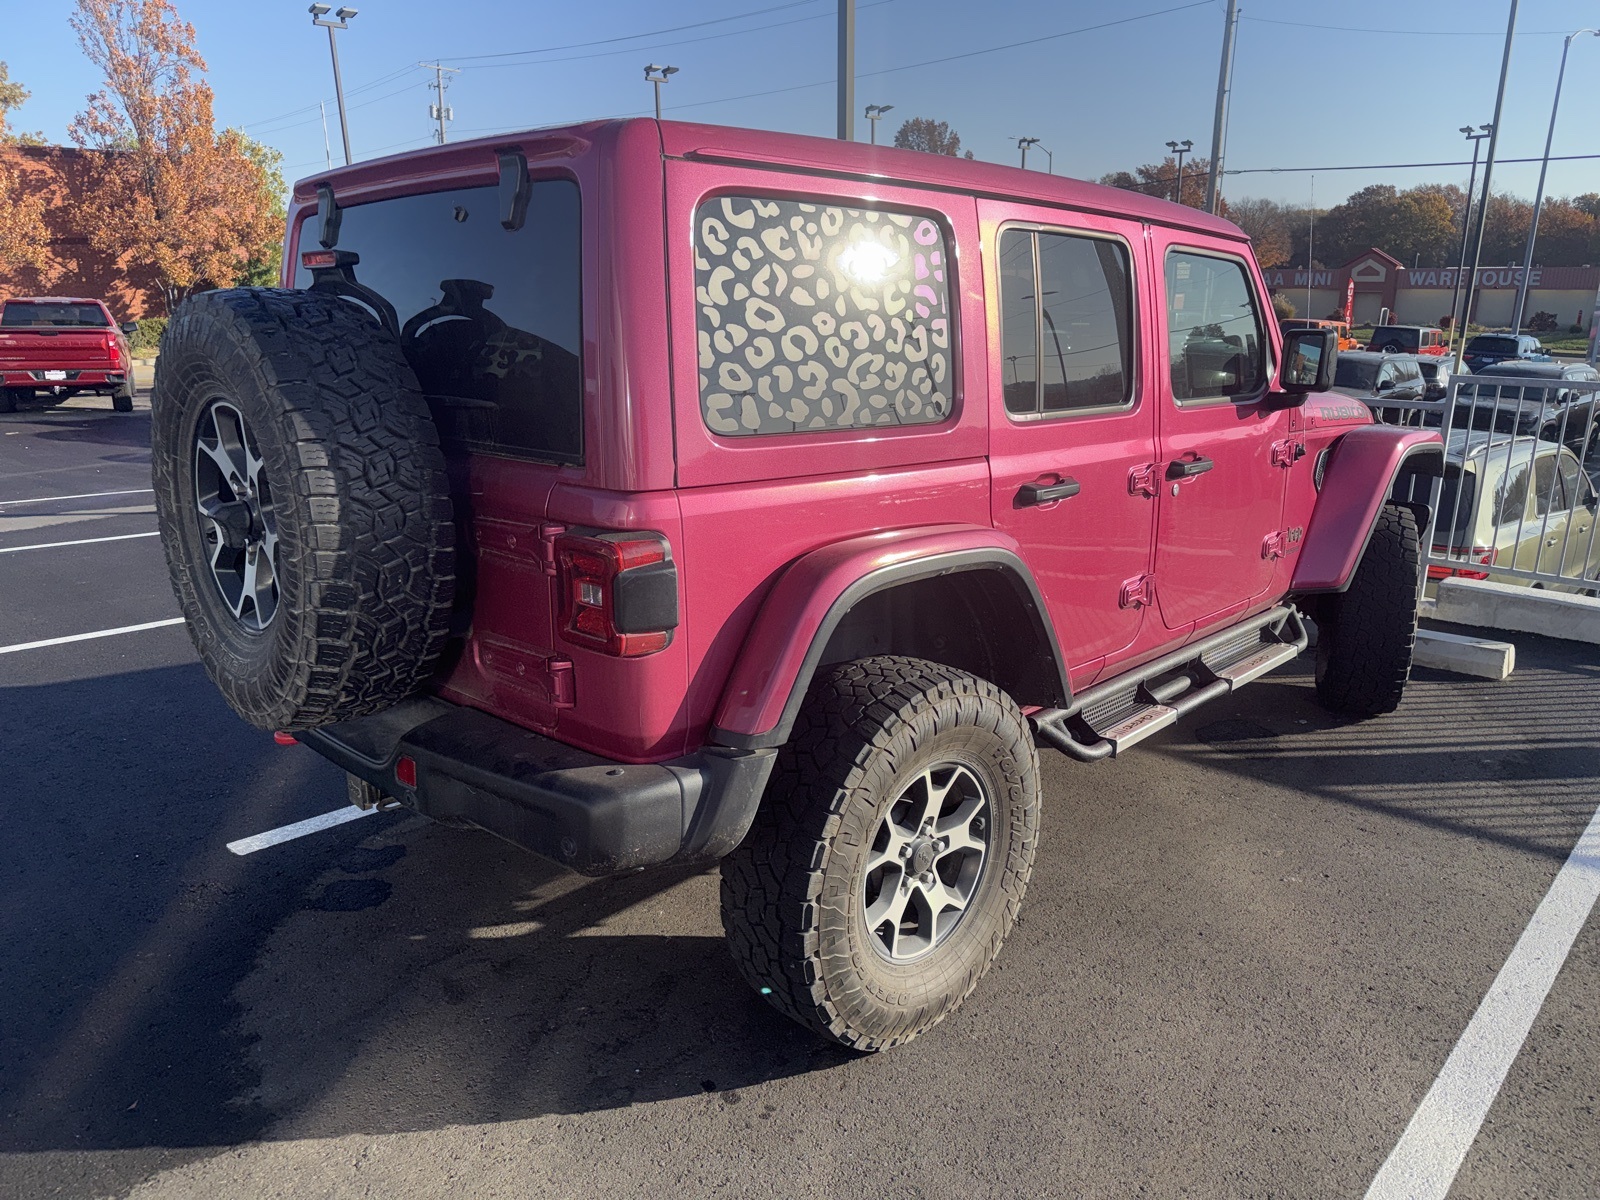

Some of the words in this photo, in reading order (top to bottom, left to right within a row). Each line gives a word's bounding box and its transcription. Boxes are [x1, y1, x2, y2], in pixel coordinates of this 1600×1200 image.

[1294, 272, 1332, 286] MINI
[1409, 271, 1542, 286] WAREOUSE
[992, 746, 1022, 801] TOYO
[1000, 805, 1023, 894] TIRES
